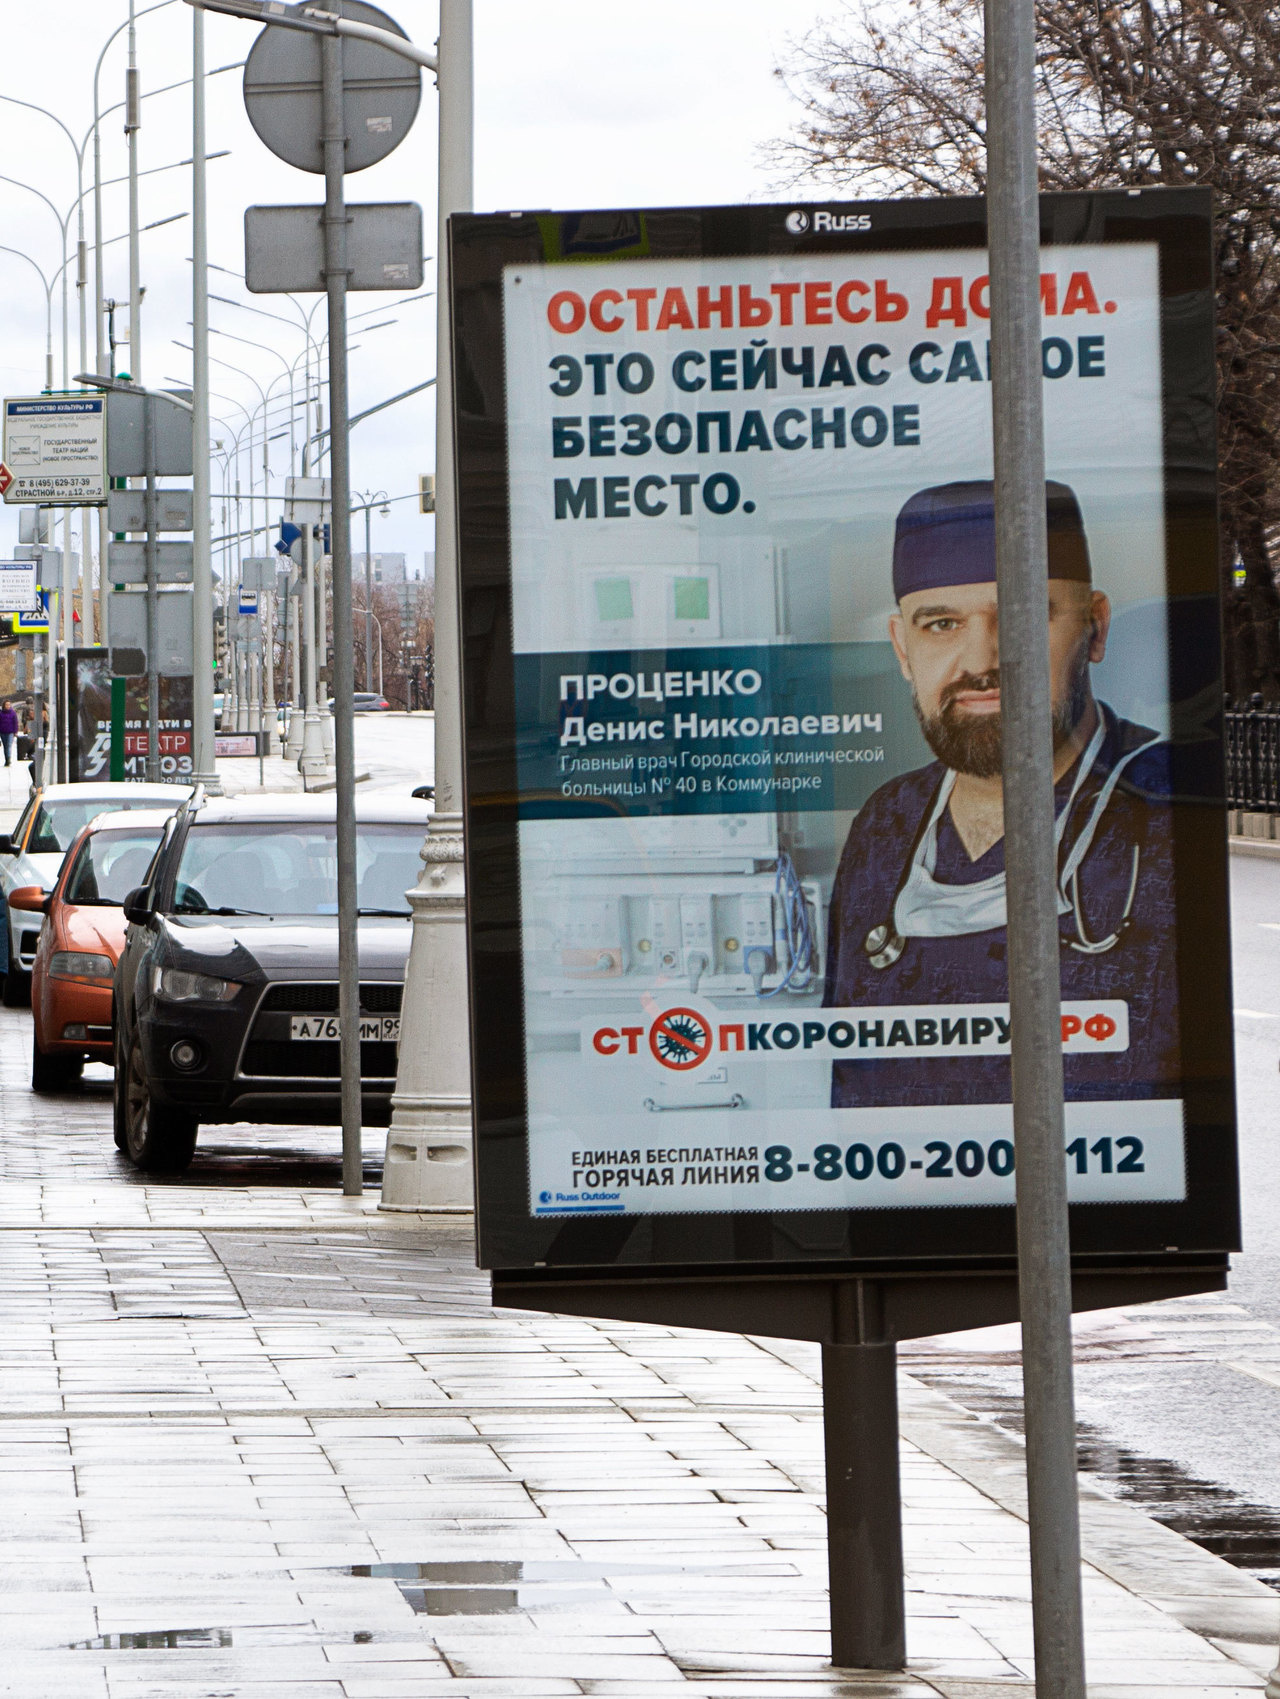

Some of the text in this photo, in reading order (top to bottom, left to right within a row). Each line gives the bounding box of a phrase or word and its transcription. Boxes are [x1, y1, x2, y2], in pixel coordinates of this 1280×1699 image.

[814, 212, 872, 231] Russ
[547, 278, 910, 334] ОСТАНЬТЕСЬ
[548, 335, 1106, 397] ЭТО СЕЙЧАС САОЕ
[43, 437, 97, 445] ГОСУДАРСТВЕННЫЙ
[552, 404, 921, 458] БЕЗОПАСНОЕ
[15, 488, 55, 497] СТРАСТНОЙ
[35, 479, 54, 488] (495)
[54, 478, 90, 486] 629-37-39
[554, 471, 757, 520] МЕСТО.
[559, 669, 762, 702] ПРОЦЕНКО
[97, 719, 142, 732] врмя
[184, 719, 192, 728] в
[560, 712, 883, 746] Денис Николаевич
[560, 745, 885, 773] Главный врач Городской клинической
[562, 779, 646, 798] больницы
[675, 776, 697, 793] 40
[702, 780, 712, 792] в
[716, 775, 822, 795] Коммунарке
[299, 1018, 379, 1038] А76ММ
[572, 1146, 759, 1167] ЕДИНАЯ БЕСПЛАТНАЯ
[573, 1165, 760, 1188] ГОРЯЧАЯ ЛИНИЯ
[556, 1191, 621, 1201] Russ Outdoor
